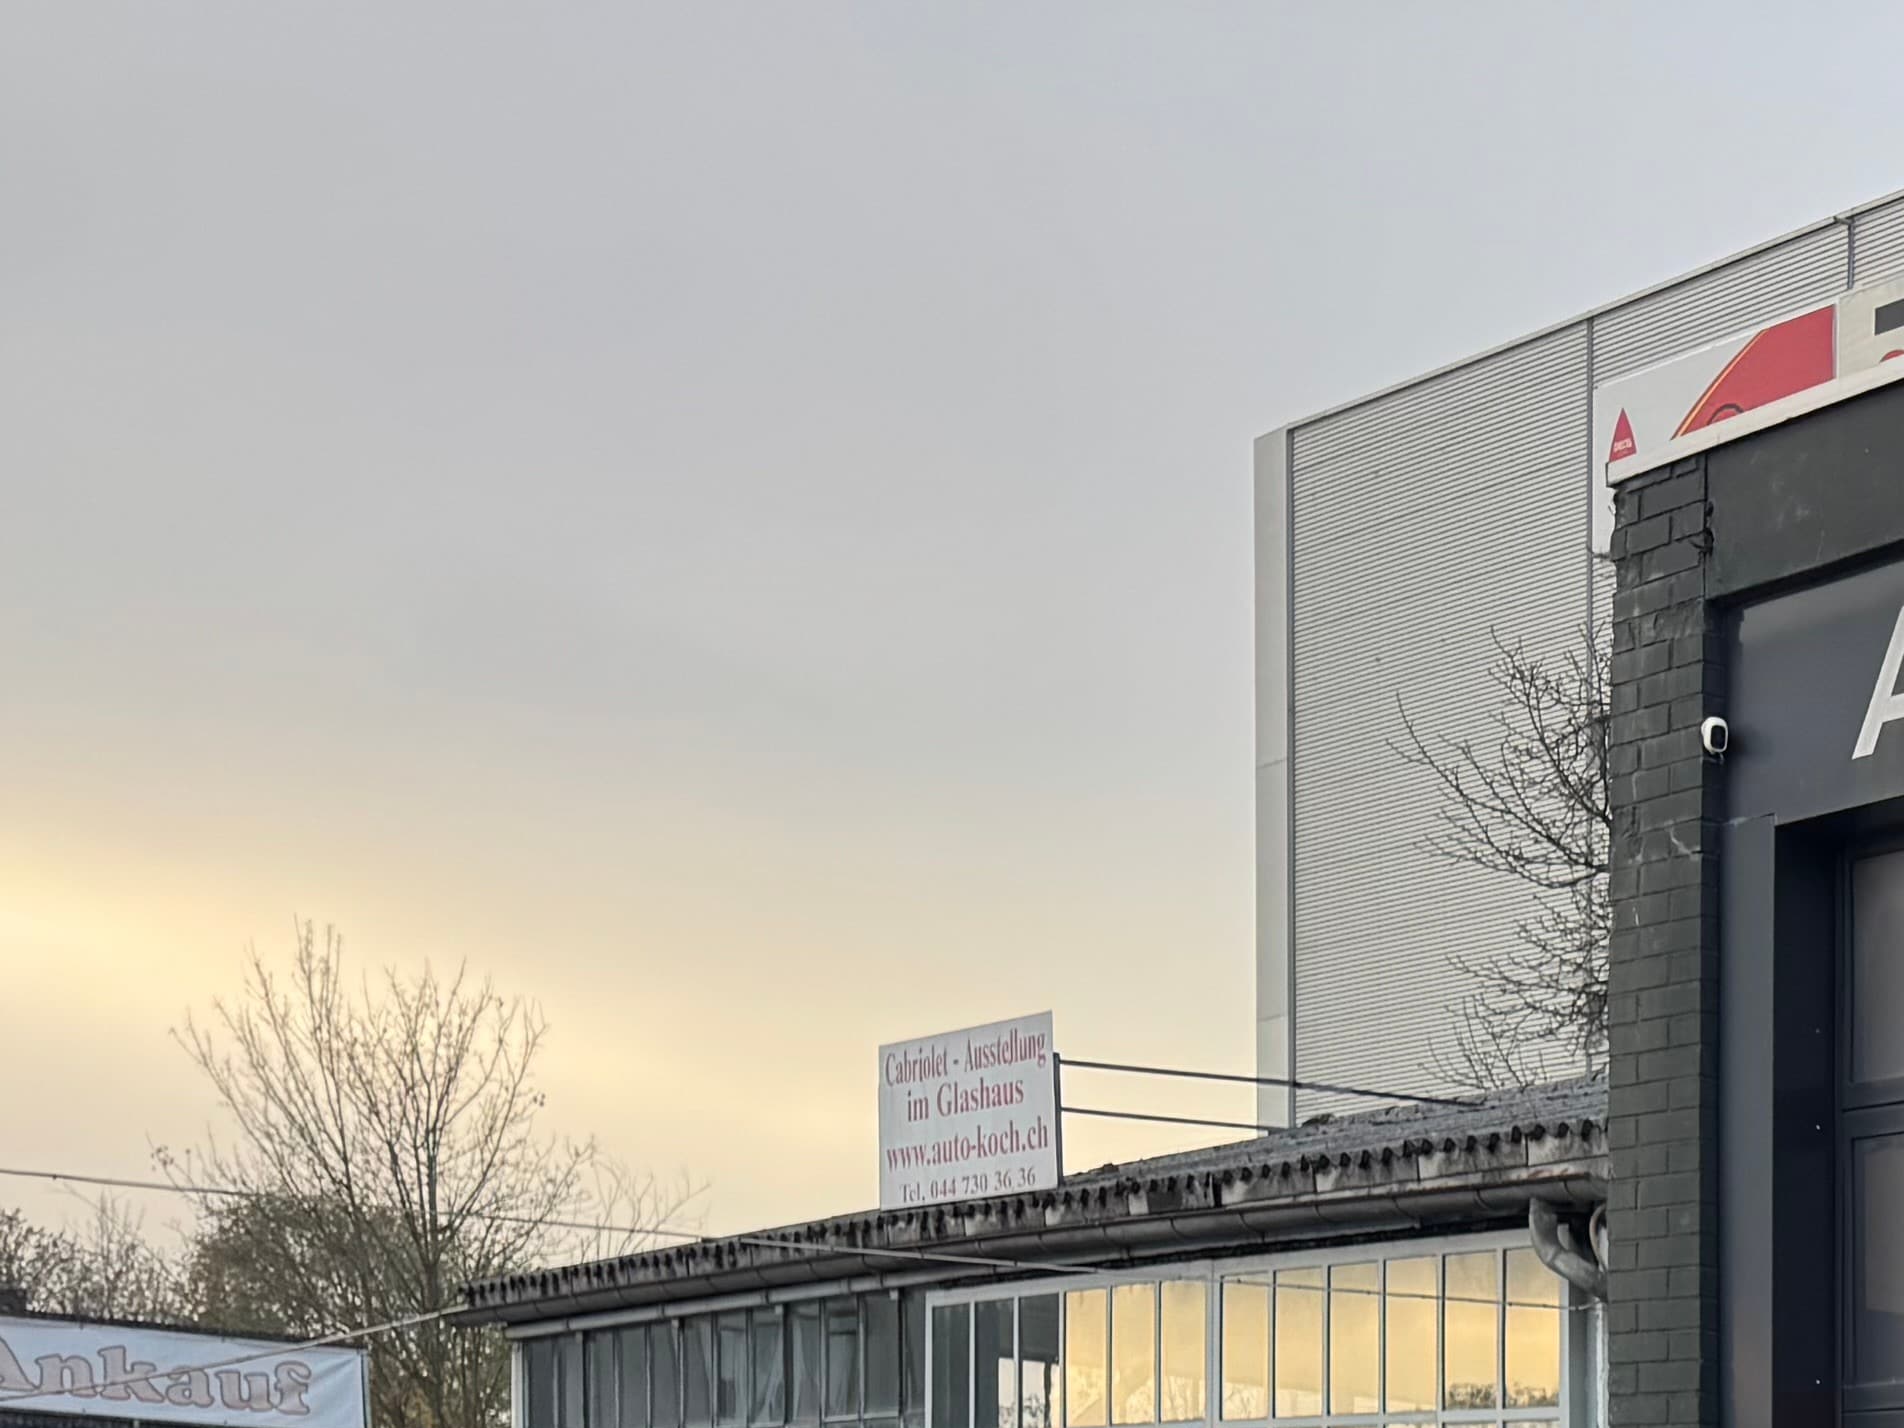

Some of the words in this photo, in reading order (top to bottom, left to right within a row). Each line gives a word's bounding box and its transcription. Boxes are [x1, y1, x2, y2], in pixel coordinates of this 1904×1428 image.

[885, 1044, 949, 1087] Cabriolet
[964, 1027, 1047, 1073] Ausstellung
[907, 1090, 930, 1122] im
[936, 1077, 1024, 1117] Glashaus
[886, 1115, 1049, 1173] www.auto-koch.ch
[930, 1178, 957, 1199] 044
[962, 1173, 989, 1195] 730
[1017, 1166, 1037, 1187] 36
